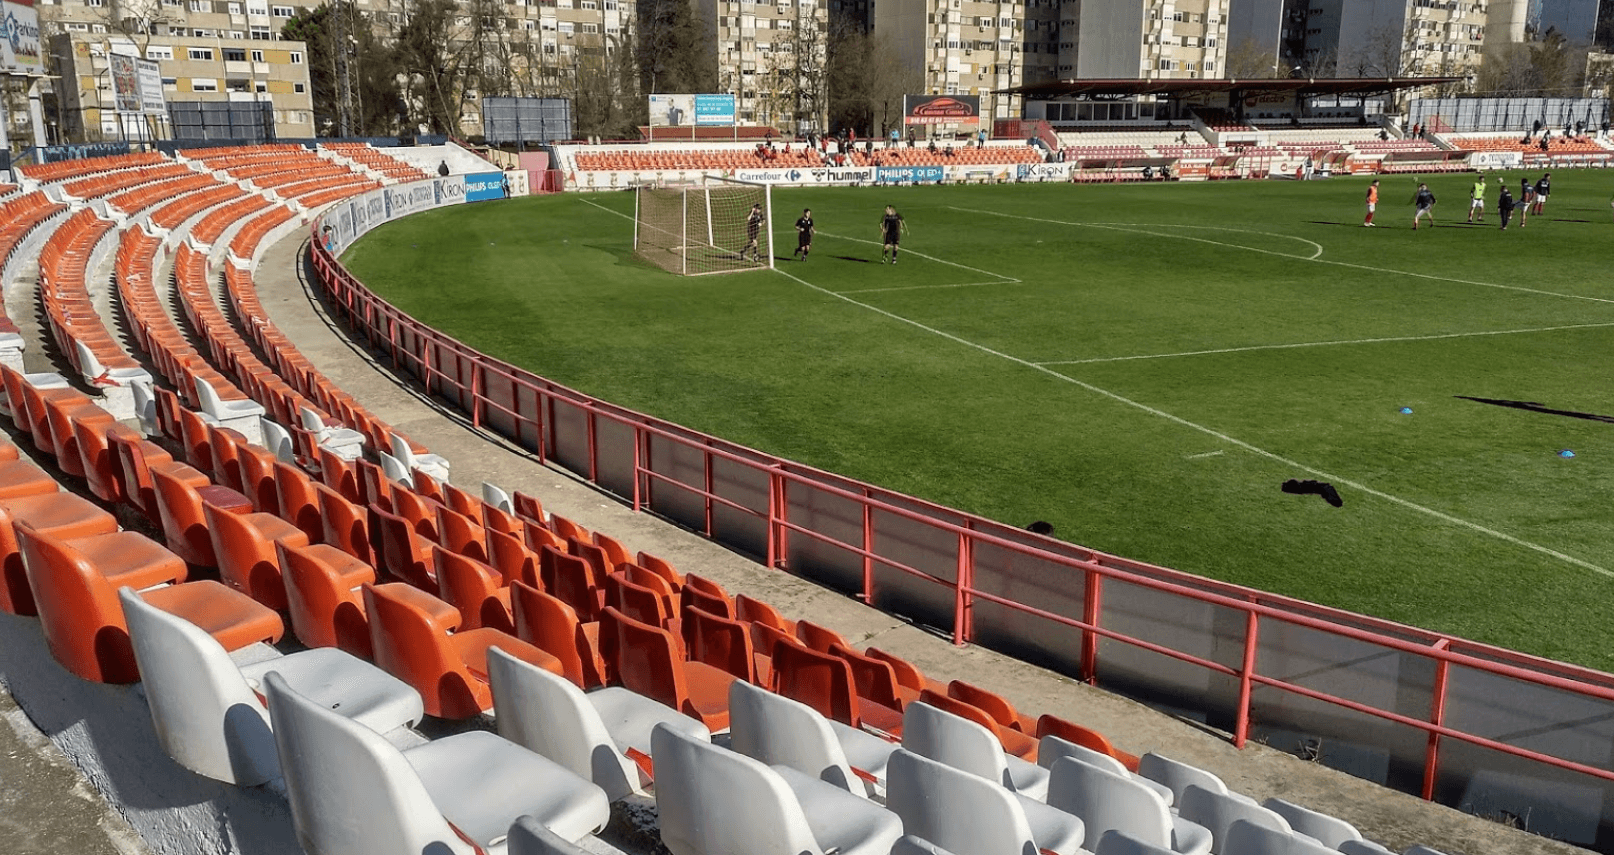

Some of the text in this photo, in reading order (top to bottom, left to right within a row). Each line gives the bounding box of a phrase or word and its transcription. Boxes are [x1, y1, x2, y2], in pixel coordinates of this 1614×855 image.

[740, 172, 782, 181] Carrefour
[827, 169, 872, 181] hummel
[878, 169, 914, 179] PHILIPS
[466, 181, 487, 193] PHILIPS
